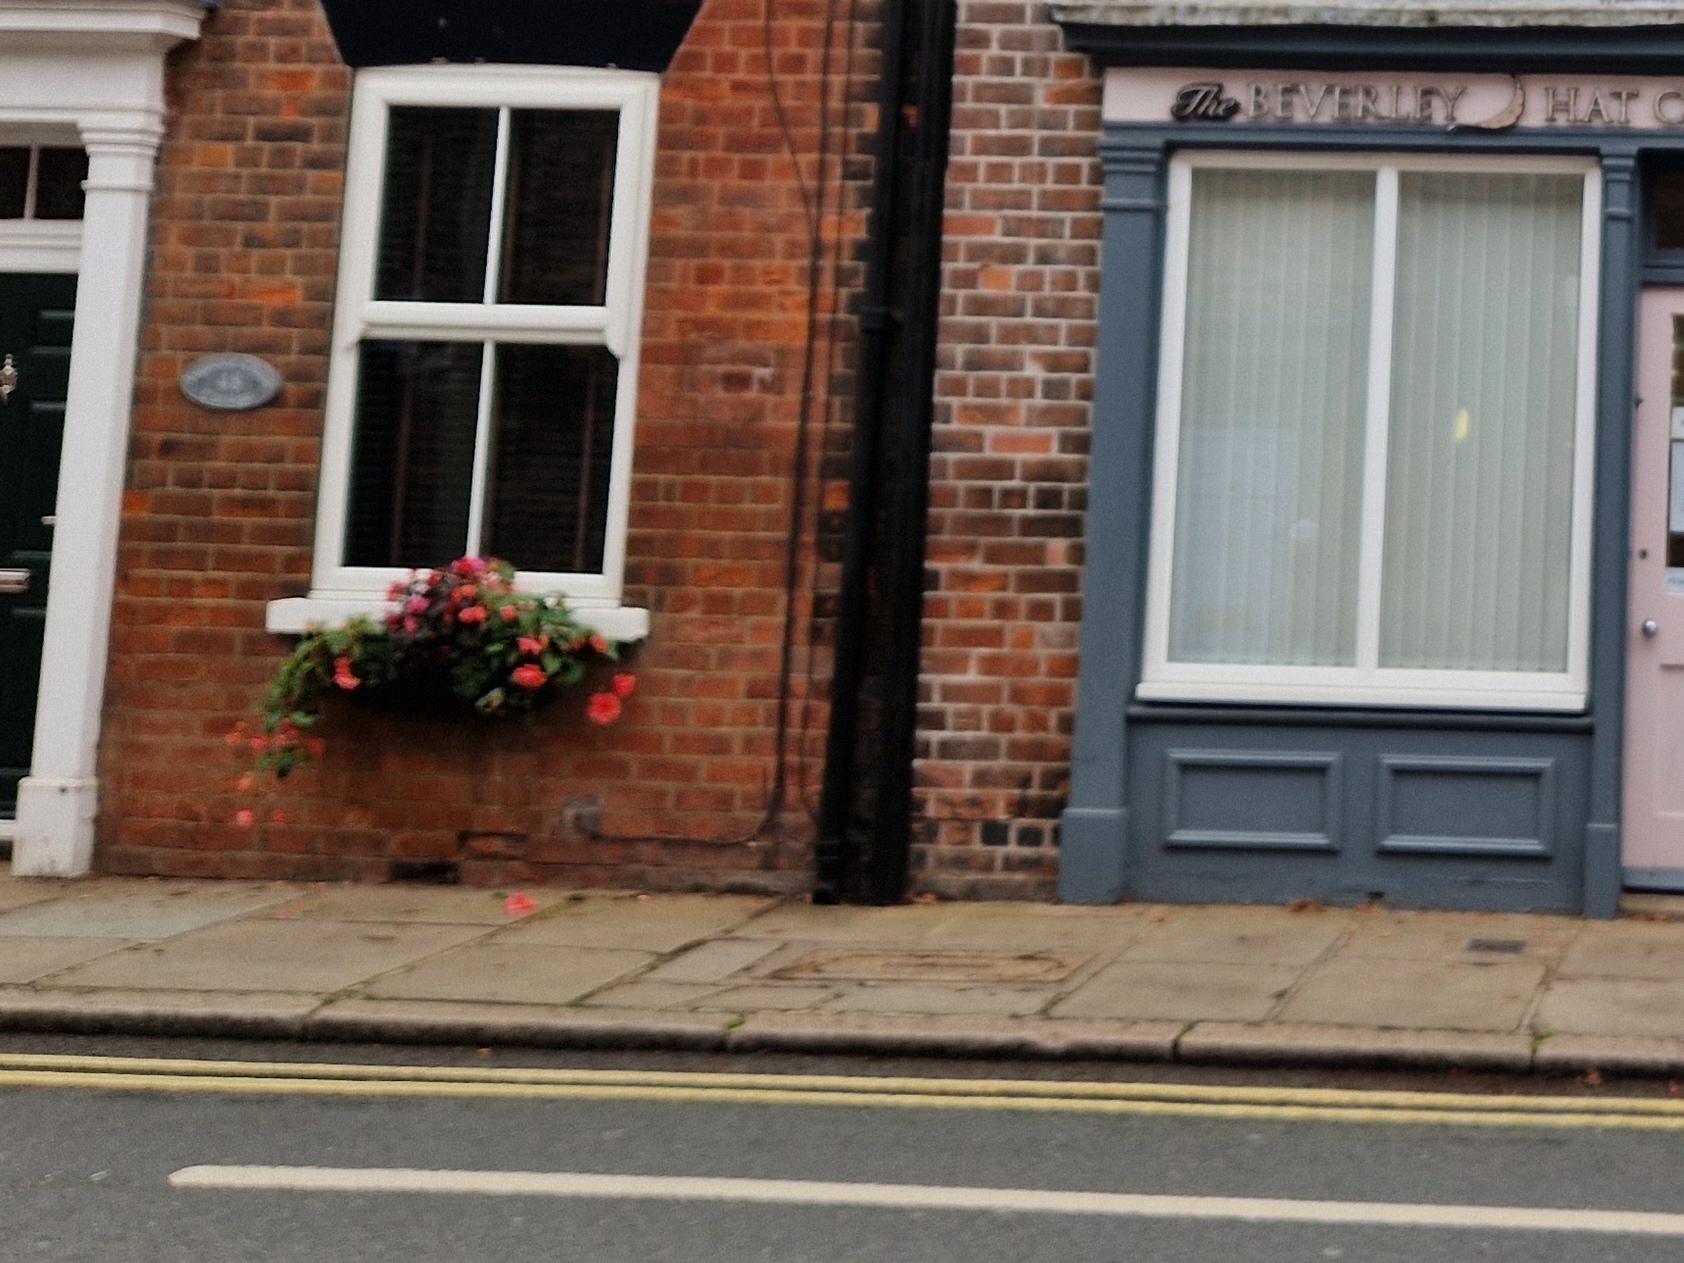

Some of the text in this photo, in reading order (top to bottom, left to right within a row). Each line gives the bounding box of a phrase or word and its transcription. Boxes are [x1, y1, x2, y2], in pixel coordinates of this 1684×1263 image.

[1170, 82, 1242, 121] The
[1249, 83, 1468, 123] BEVERLEY
[1544, 86, 1640, 125] HAT
